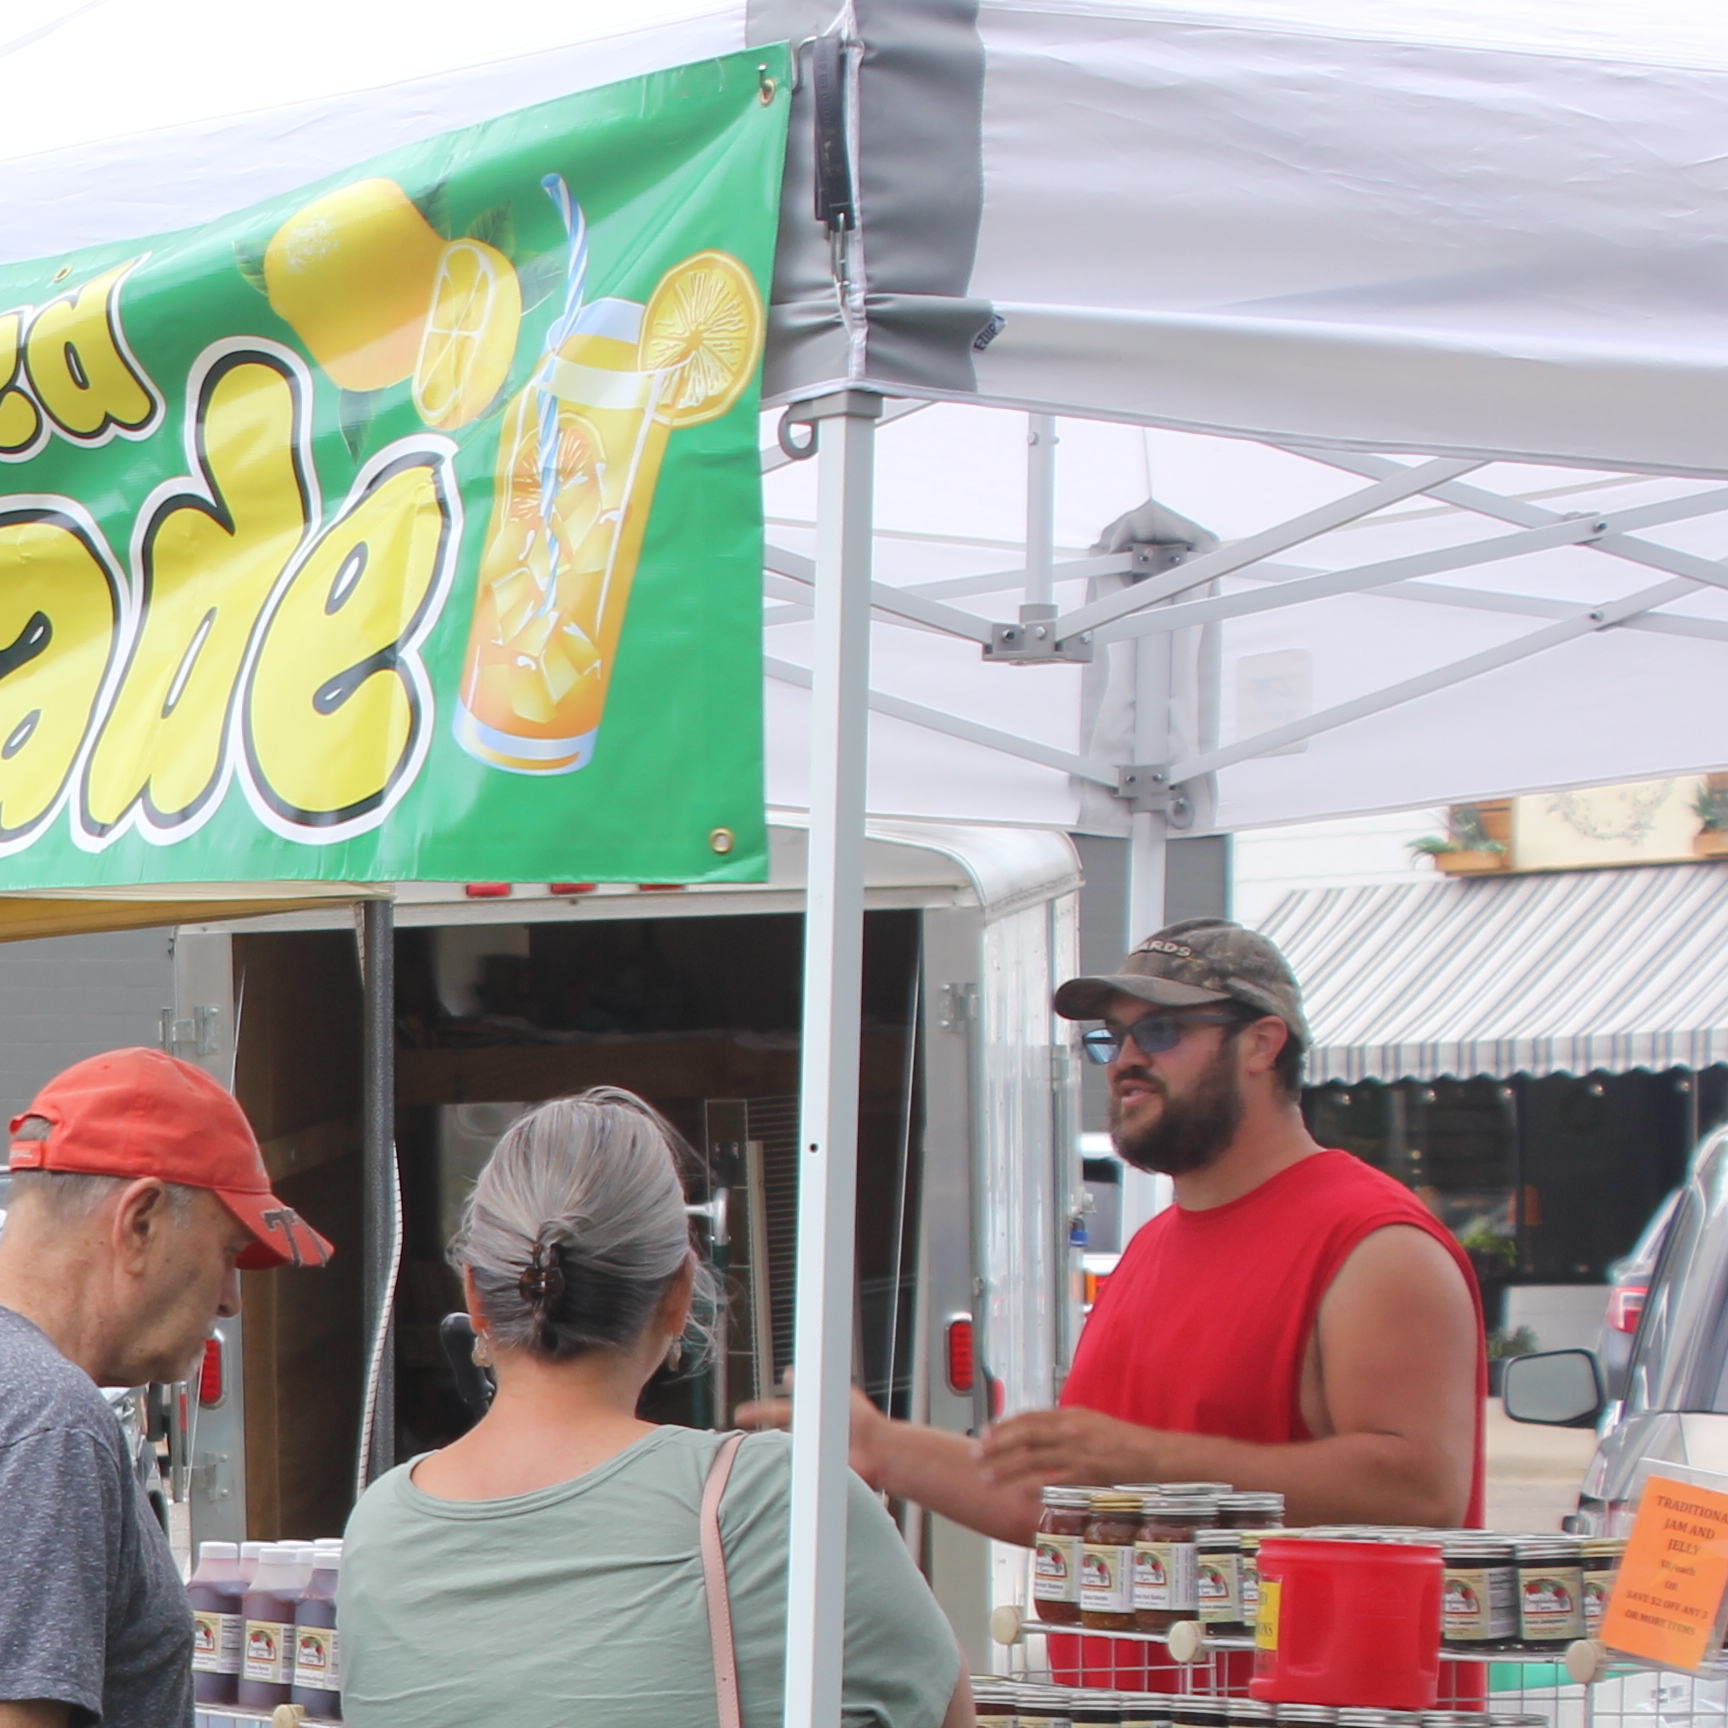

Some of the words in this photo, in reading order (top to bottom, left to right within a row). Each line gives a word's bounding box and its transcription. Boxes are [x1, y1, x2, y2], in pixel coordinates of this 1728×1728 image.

[1663, 1518, 1688, 1533] JAM
[1687, 1522, 1715, 1540] AND
[1667, 1538, 1701, 1556] JELLY
[1625, 1589, 1651, 1606] SAVE
[1663, 1600, 1682, 1612] OFF
[1640, 1613, 1667, 1628] MORE
